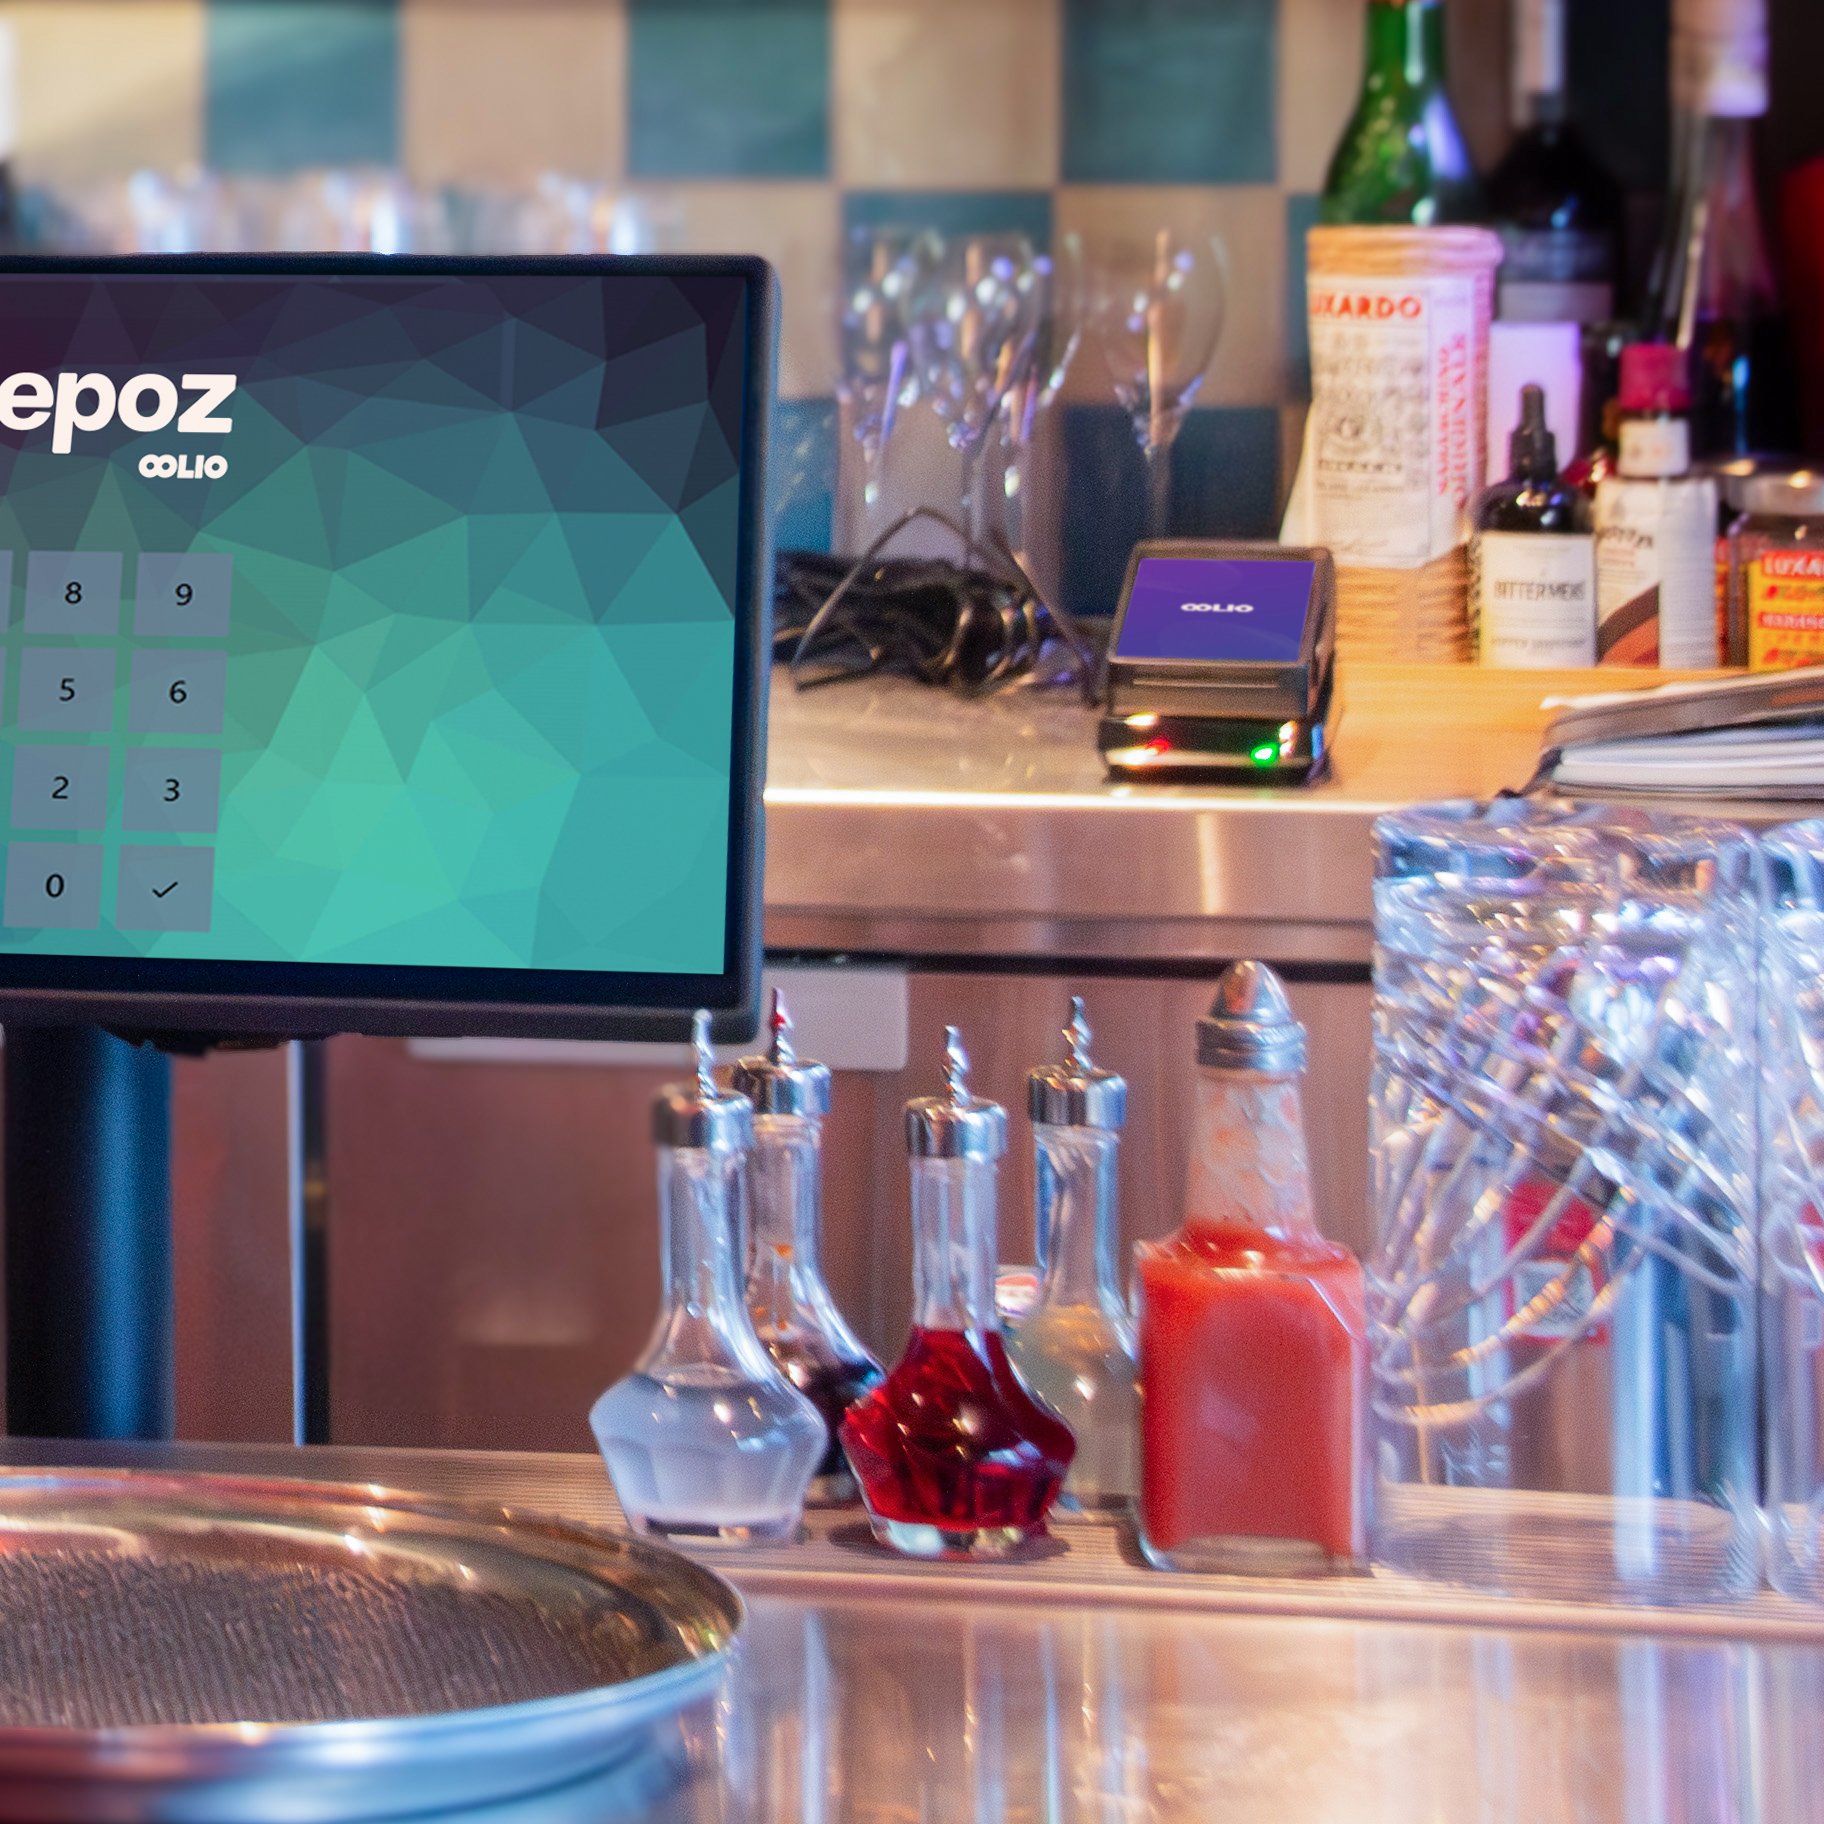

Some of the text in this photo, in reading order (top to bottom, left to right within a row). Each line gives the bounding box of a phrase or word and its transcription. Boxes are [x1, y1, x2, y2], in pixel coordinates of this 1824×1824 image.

[1310, 293, 1422, 319] UXARDO
[64, 582, 82, 604] 8
[175, 583, 193, 605] 9
[59, 679, 75, 701] 5
[169, 680, 187, 703] 6
[52, 776, 69, 799] 2
[163, 778, 180, 802] 3
[45, 874, 64, 898] 0
